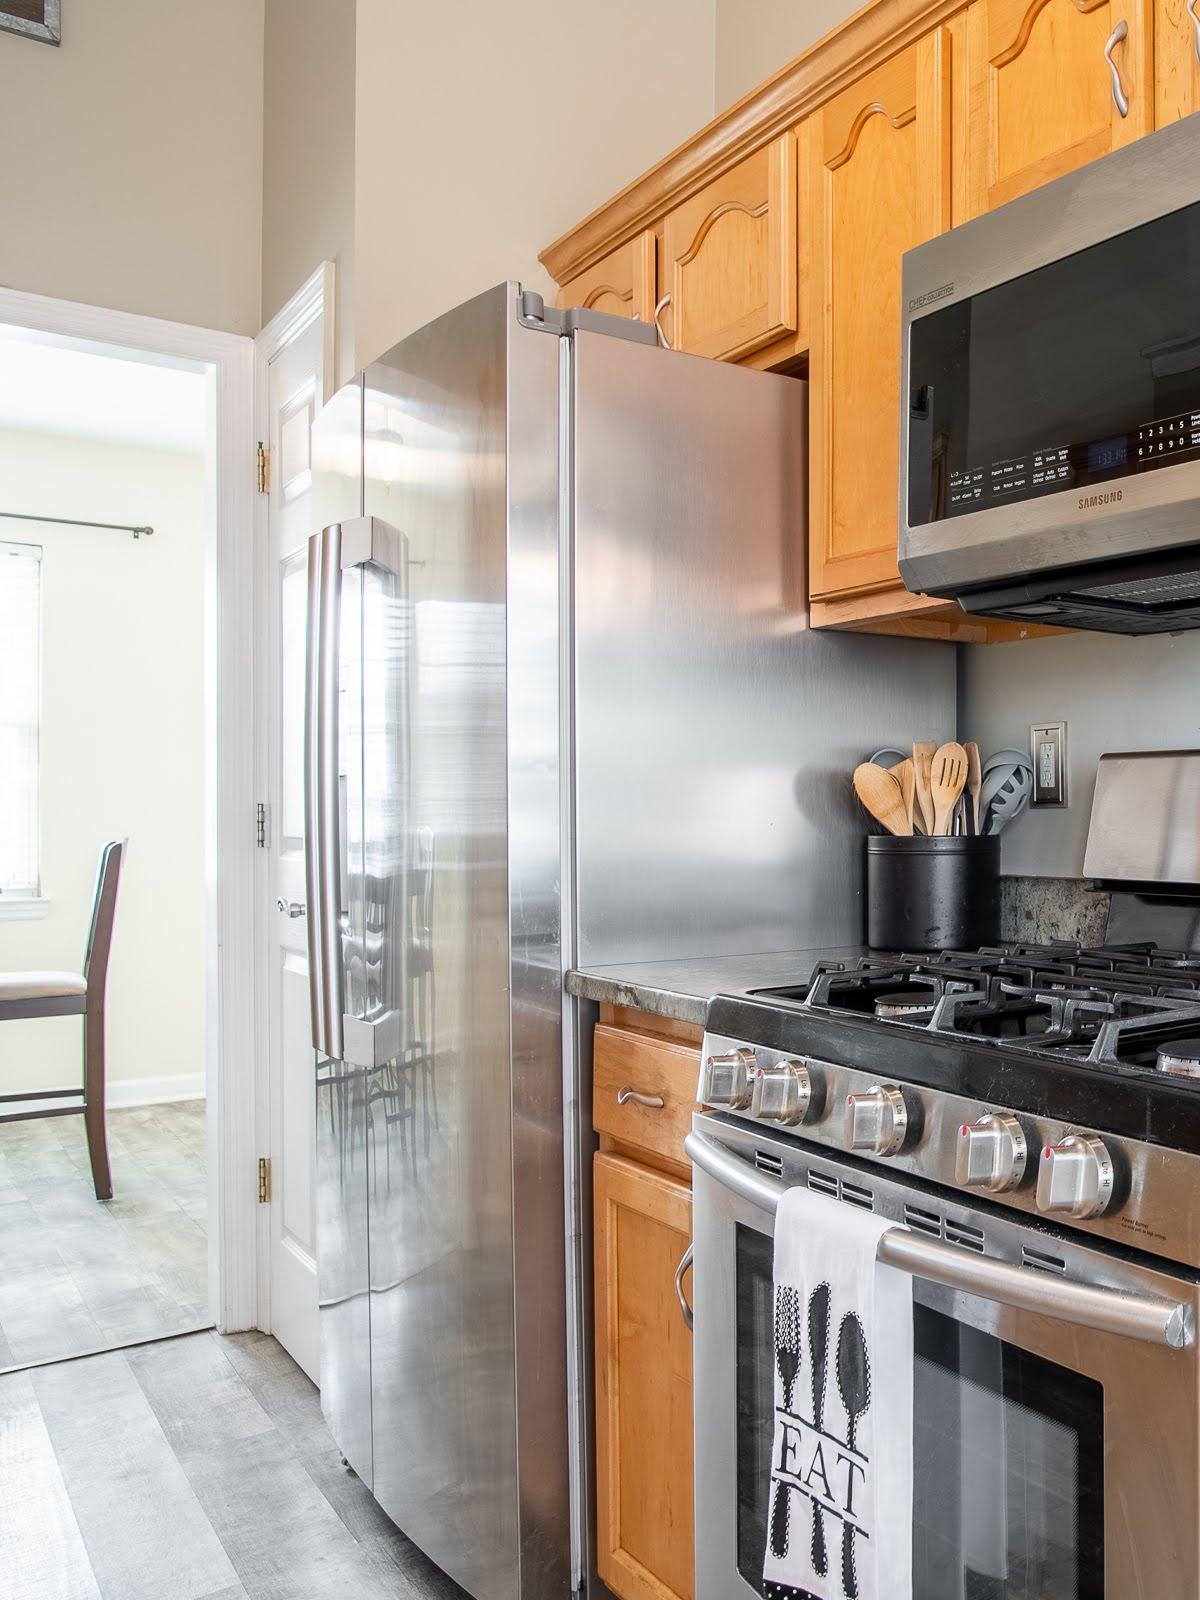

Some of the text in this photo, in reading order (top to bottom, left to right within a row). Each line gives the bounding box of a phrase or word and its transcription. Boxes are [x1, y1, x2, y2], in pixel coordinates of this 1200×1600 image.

[909, 295, 927, 310] CHEF
[1078, 490, 1122, 510] SAMSUNG
[775, 1420, 866, 1518] EAT
